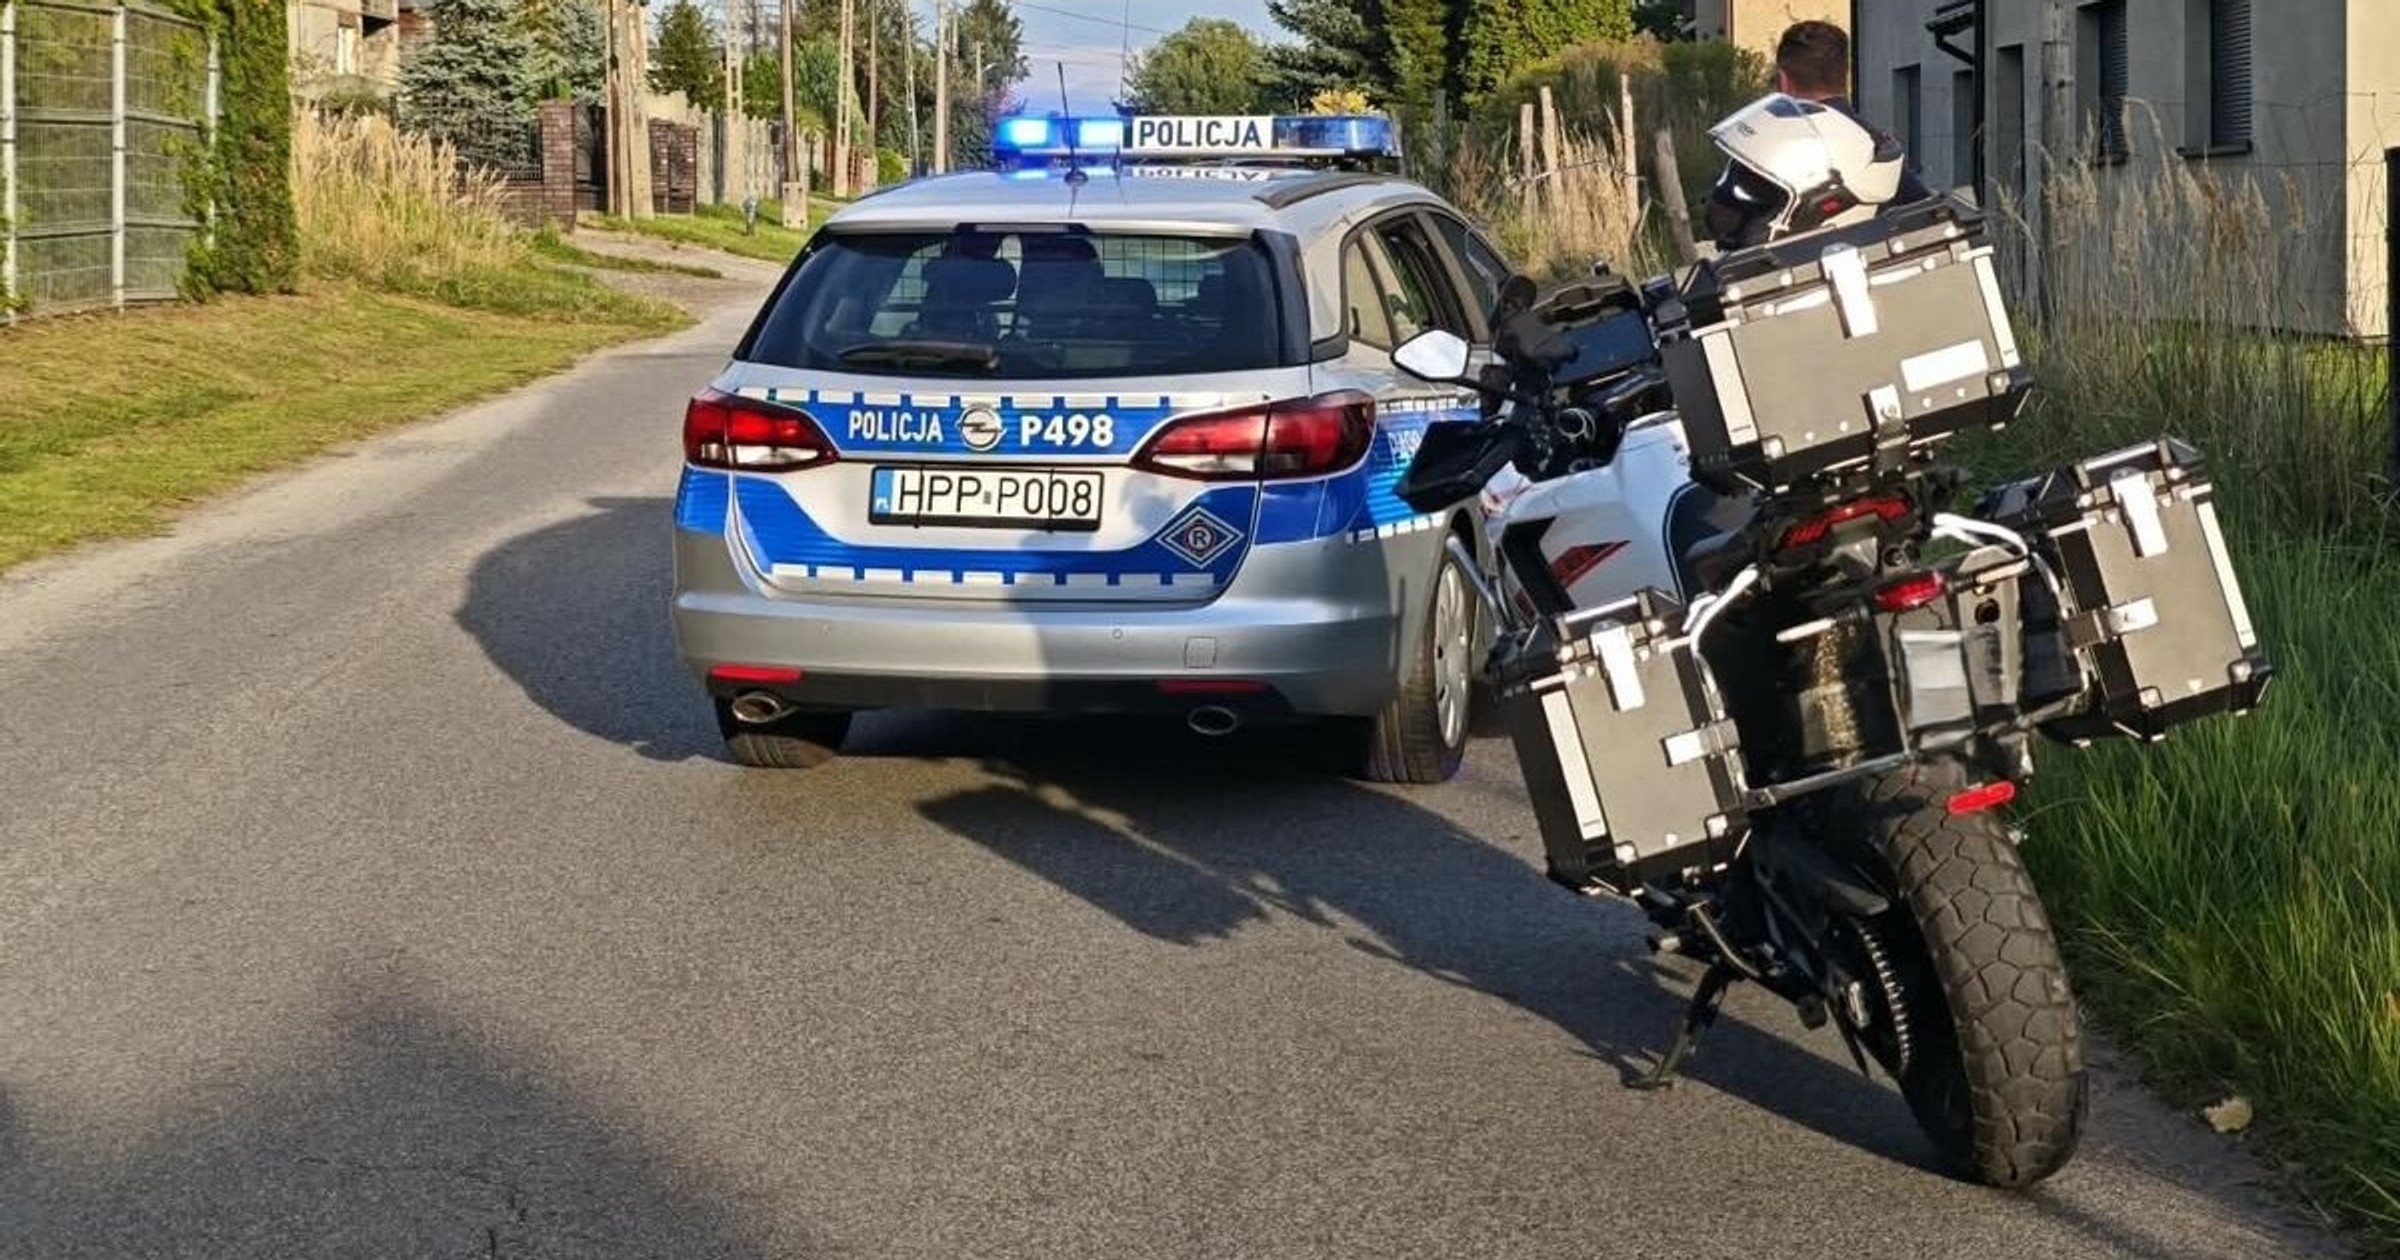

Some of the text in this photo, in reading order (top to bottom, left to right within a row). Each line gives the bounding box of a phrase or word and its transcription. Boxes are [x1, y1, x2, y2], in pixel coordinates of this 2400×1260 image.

[1139, 120, 1262, 148] POLICJA
[849, 410, 1113, 446] POLICJA P498
[899, 473, 981, 513] HPP
[1192, 529, 1207, 546] R
